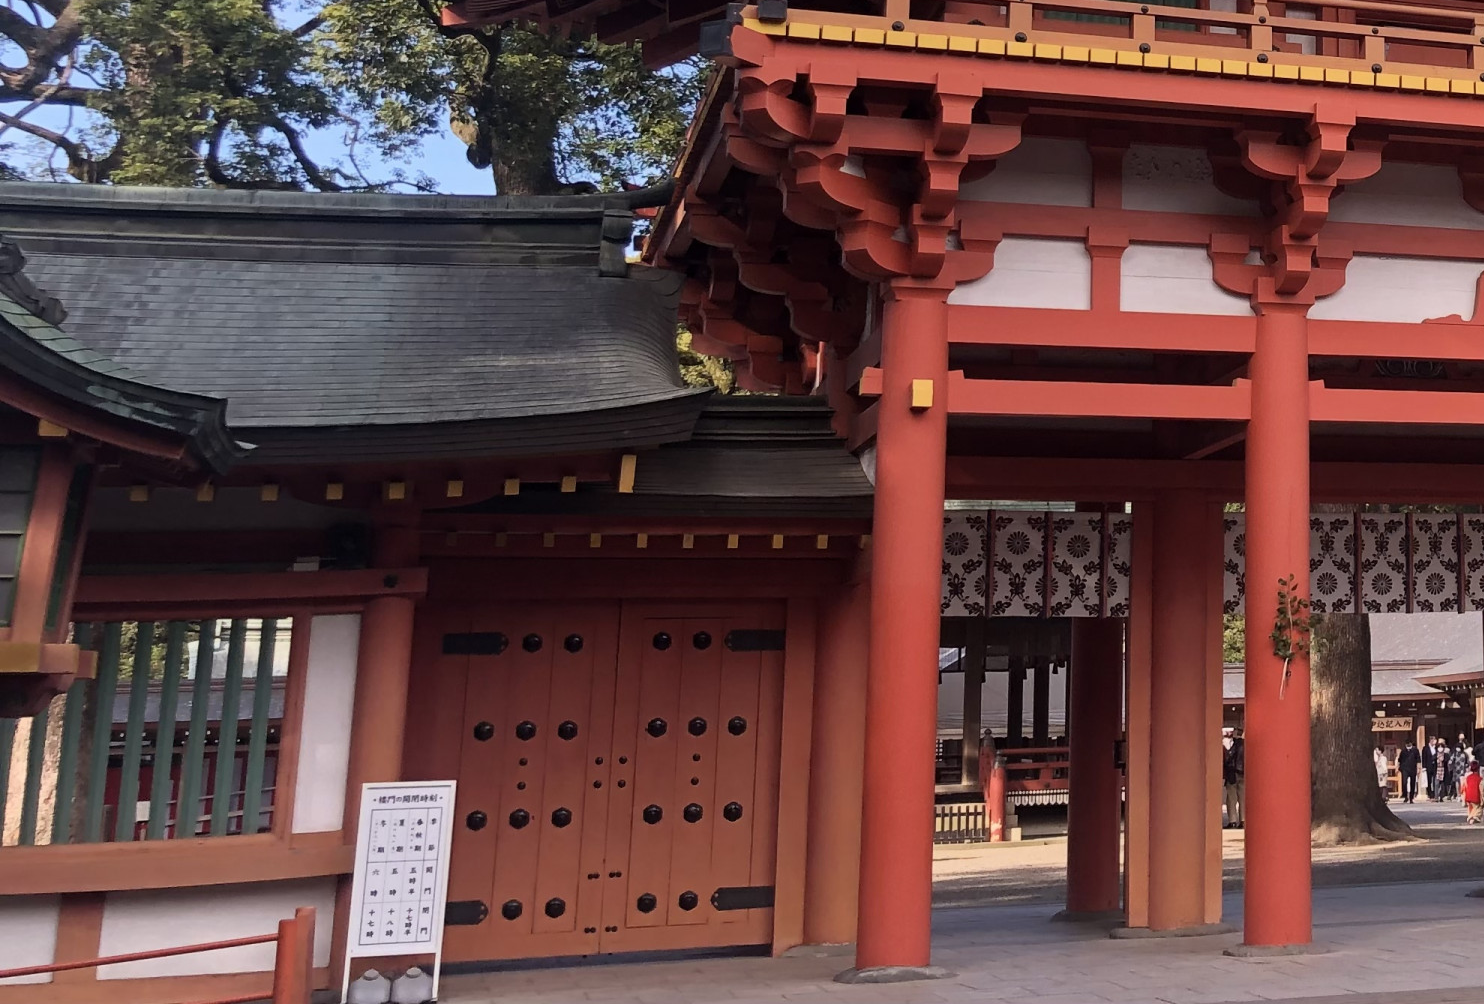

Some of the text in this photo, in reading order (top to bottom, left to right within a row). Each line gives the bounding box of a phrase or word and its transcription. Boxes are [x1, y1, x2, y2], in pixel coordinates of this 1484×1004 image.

[370, 869, 380, 897] 六時
[366, 909, 376, 938] 十七時
[385, 908, 395, 937] 十八時
